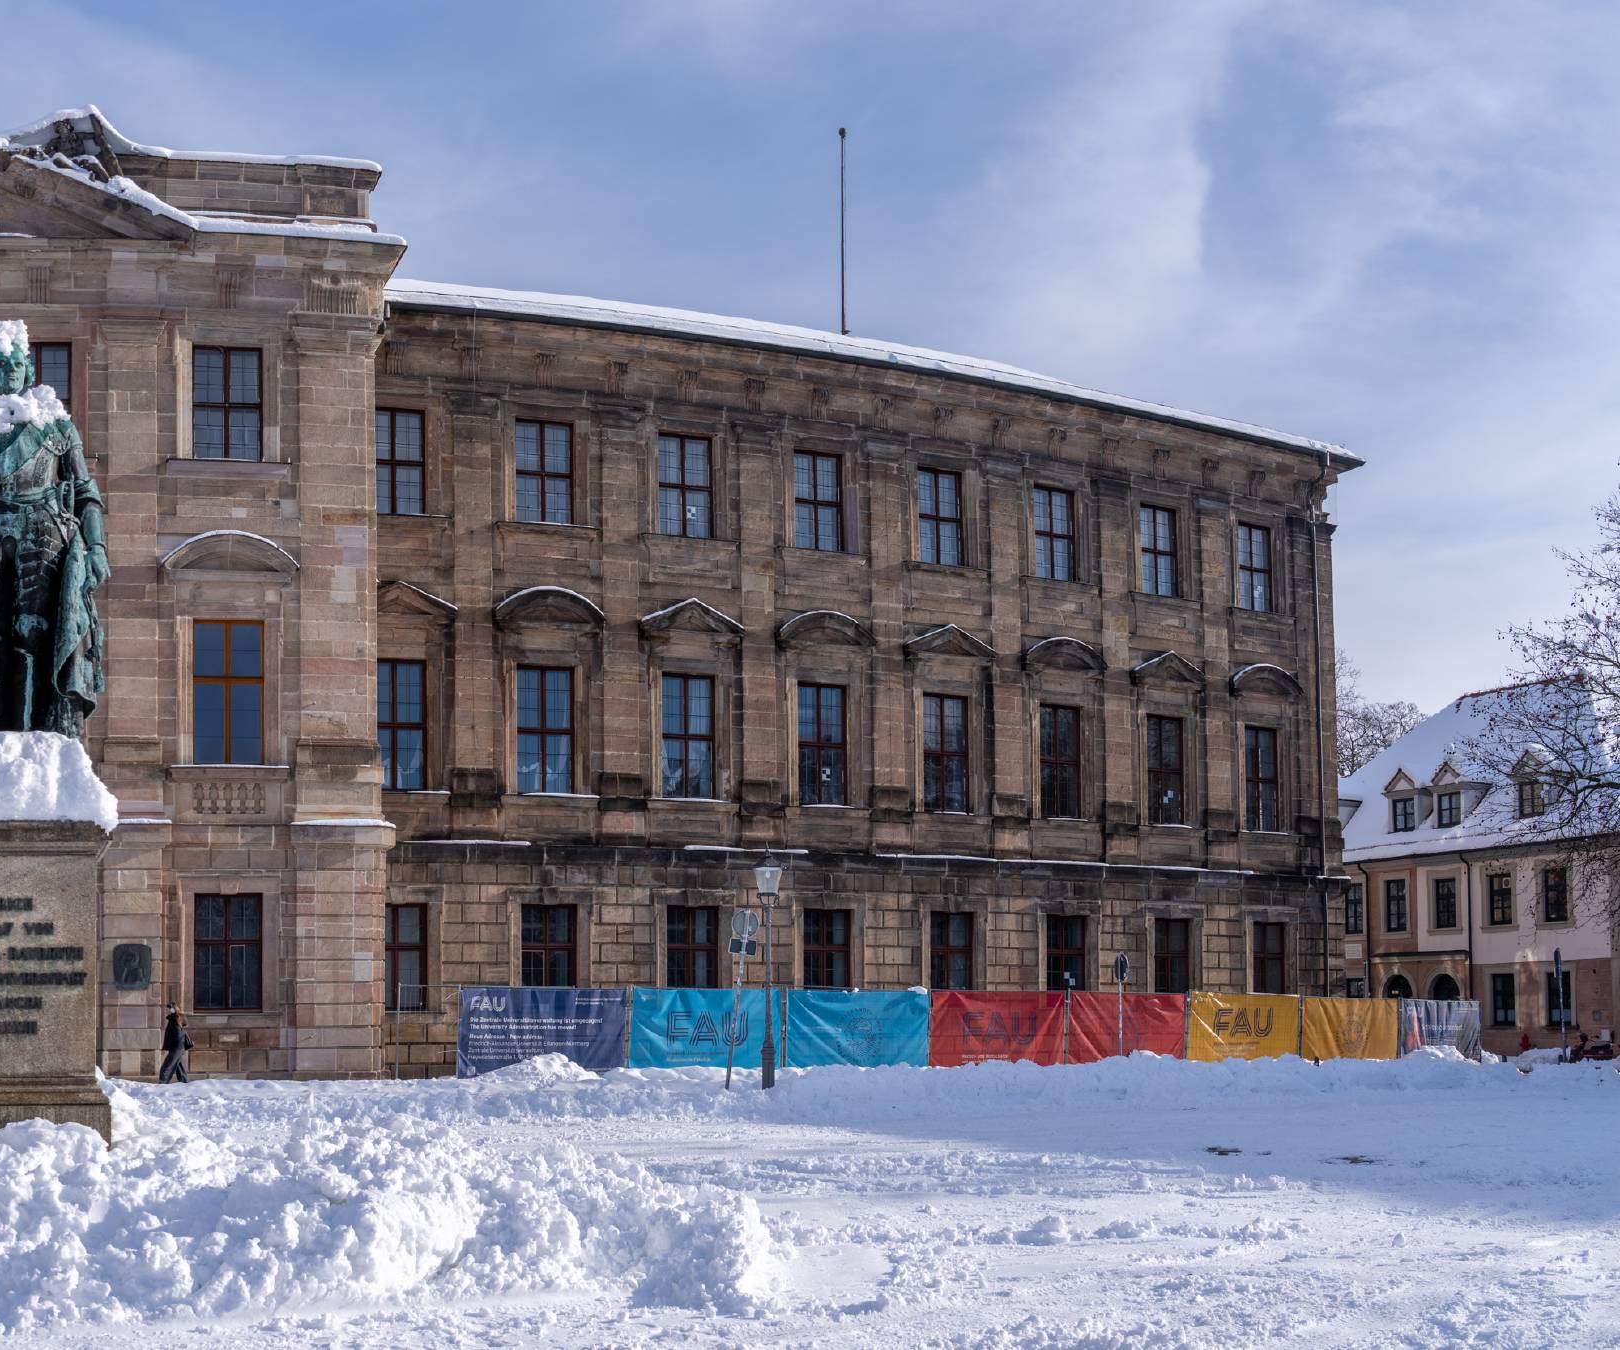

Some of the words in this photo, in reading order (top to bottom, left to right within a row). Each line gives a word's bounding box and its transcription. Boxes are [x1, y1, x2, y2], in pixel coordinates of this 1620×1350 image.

[22, 922, 54, 936] VON
[470, 996, 506, 1012] FAU
[666, 1010, 748, 1047] FAU
[962, 1011, 1037, 1045] FAU
[1213, 1007, 1273, 1037] FAU
